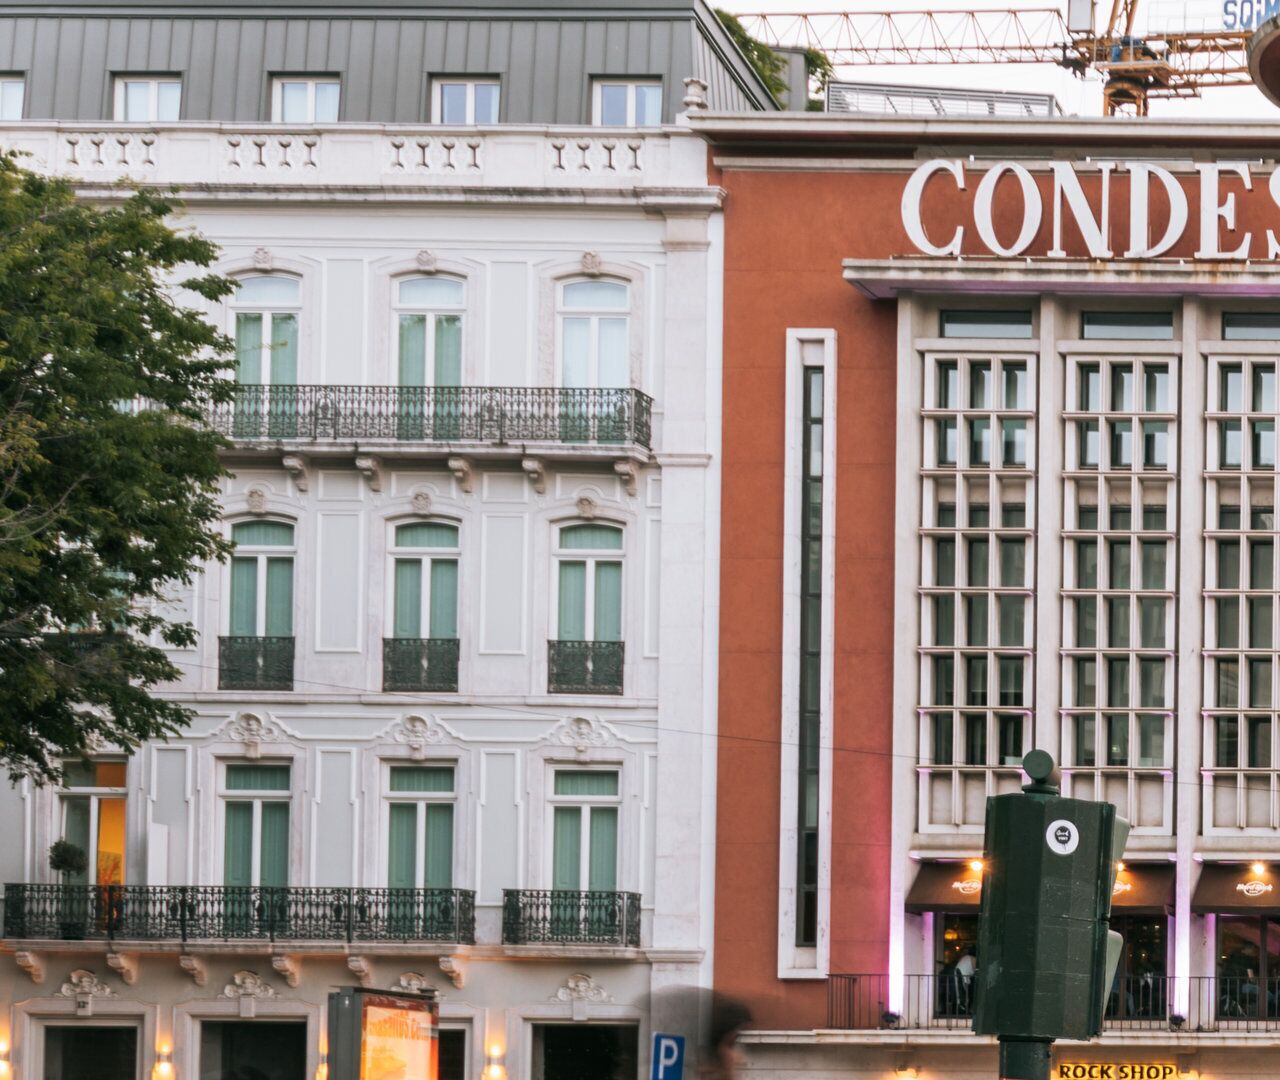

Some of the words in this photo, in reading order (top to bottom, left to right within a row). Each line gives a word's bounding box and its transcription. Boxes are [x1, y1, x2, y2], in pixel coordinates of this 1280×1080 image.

[658, 1038, 678, 1080] P
[1059, 1065, 1113, 1079] ROCK
[1119, 1066, 1173, 1080] SHOP
